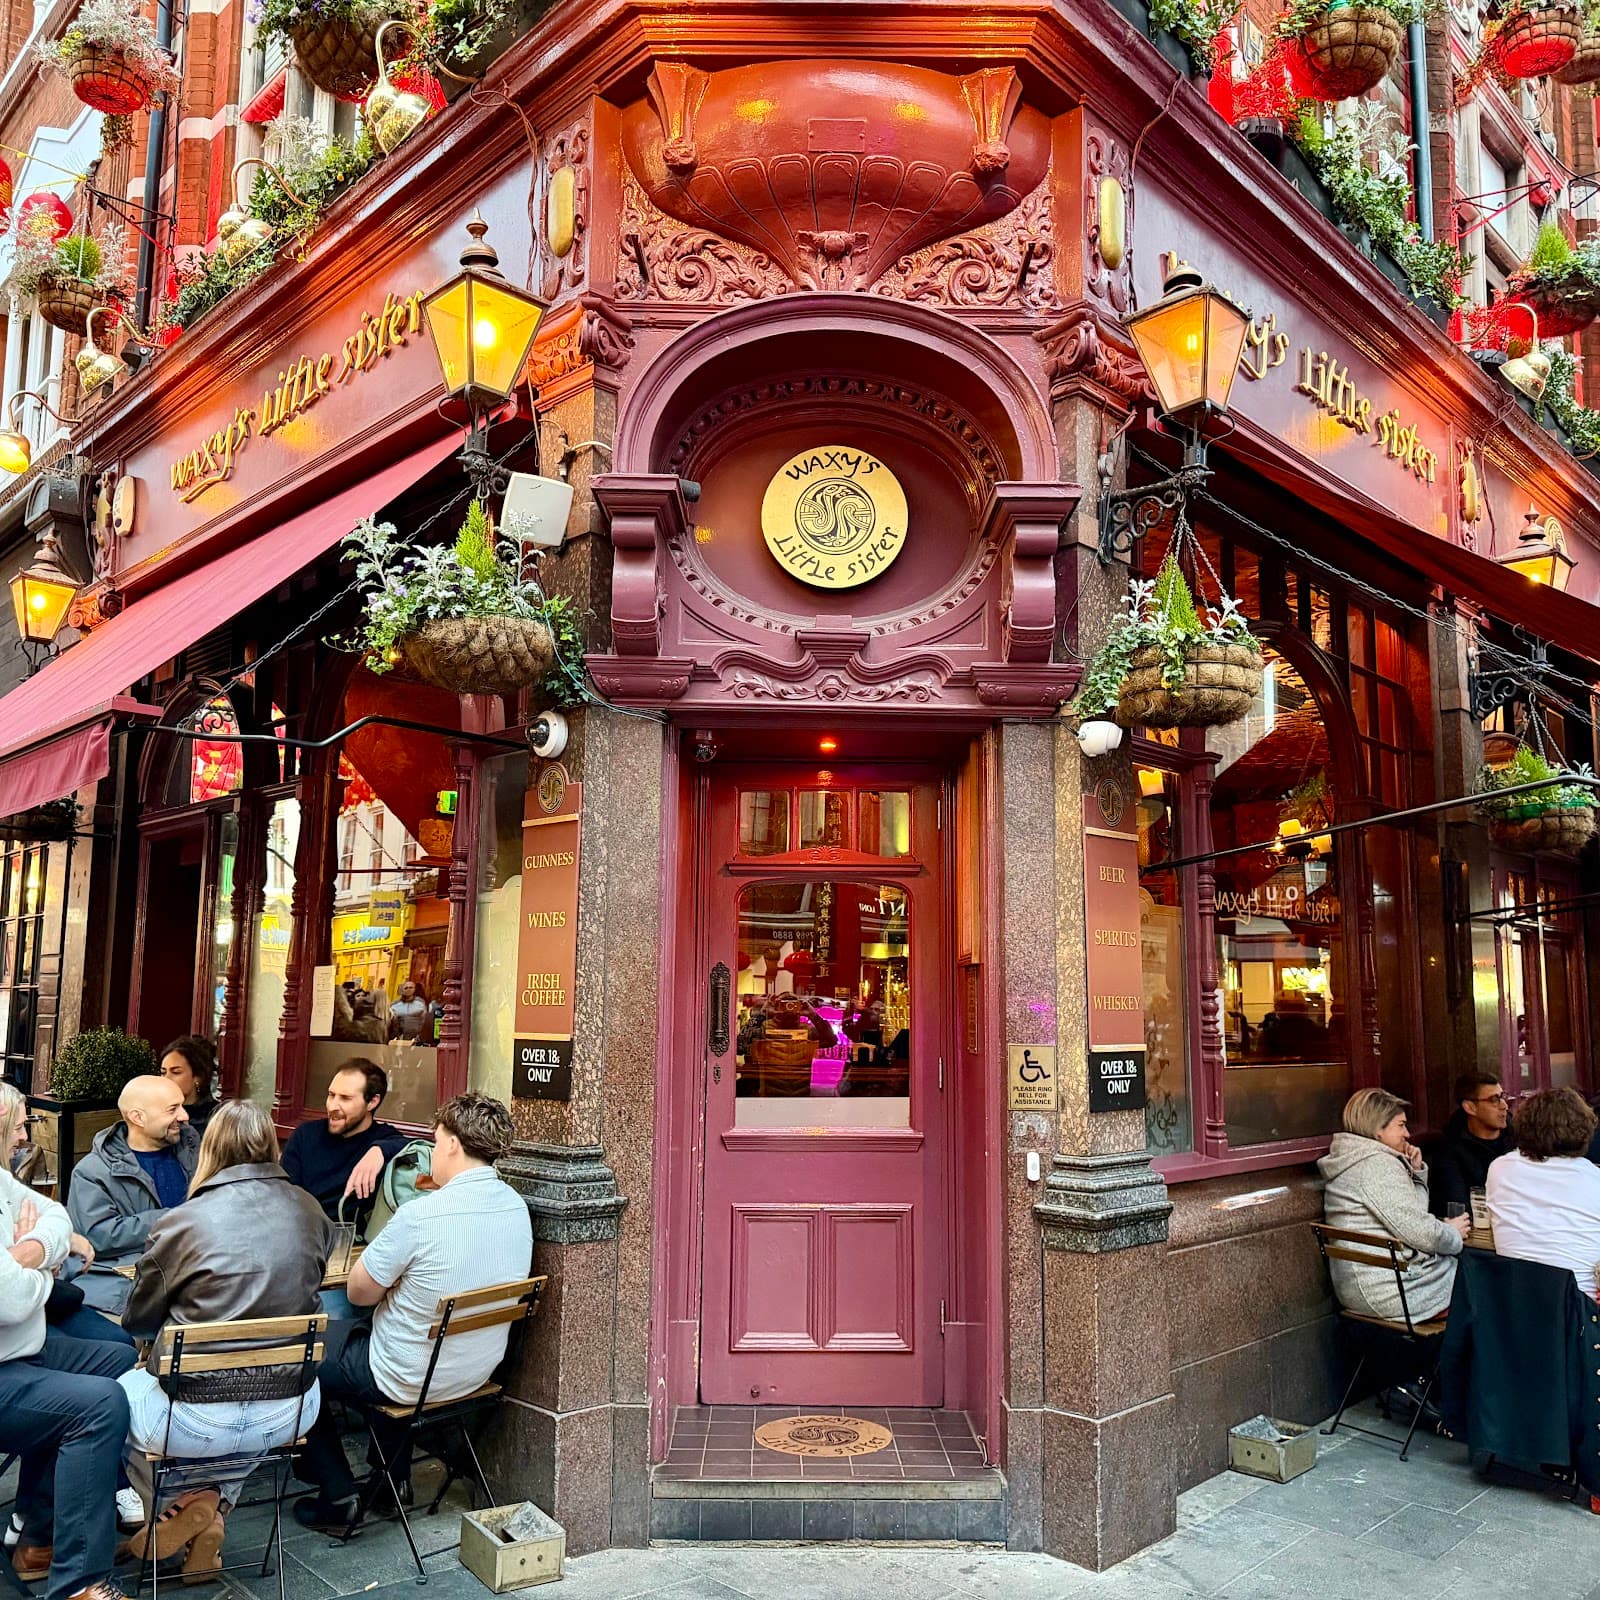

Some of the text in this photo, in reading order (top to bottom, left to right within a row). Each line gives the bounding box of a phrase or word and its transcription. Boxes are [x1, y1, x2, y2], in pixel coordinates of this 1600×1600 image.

[525, 852, 574, 869] GUINNESS
[1100, 866, 1126, 883] BEER
[528, 911, 566, 928] WINES
[1095, 929, 1137, 947] SPIRITS
[527, 973, 561, 990] IRISH
[522, 990, 566, 1006] COFFEE
[1093, 995, 1141, 1010] WHISKEY
[522, 1048, 545, 1063] OVER
[528, 1068, 552, 1083] ONLY
[1100, 1060, 1124, 1076] OVER
[1107, 1079, 1131, 1095] ONLY
